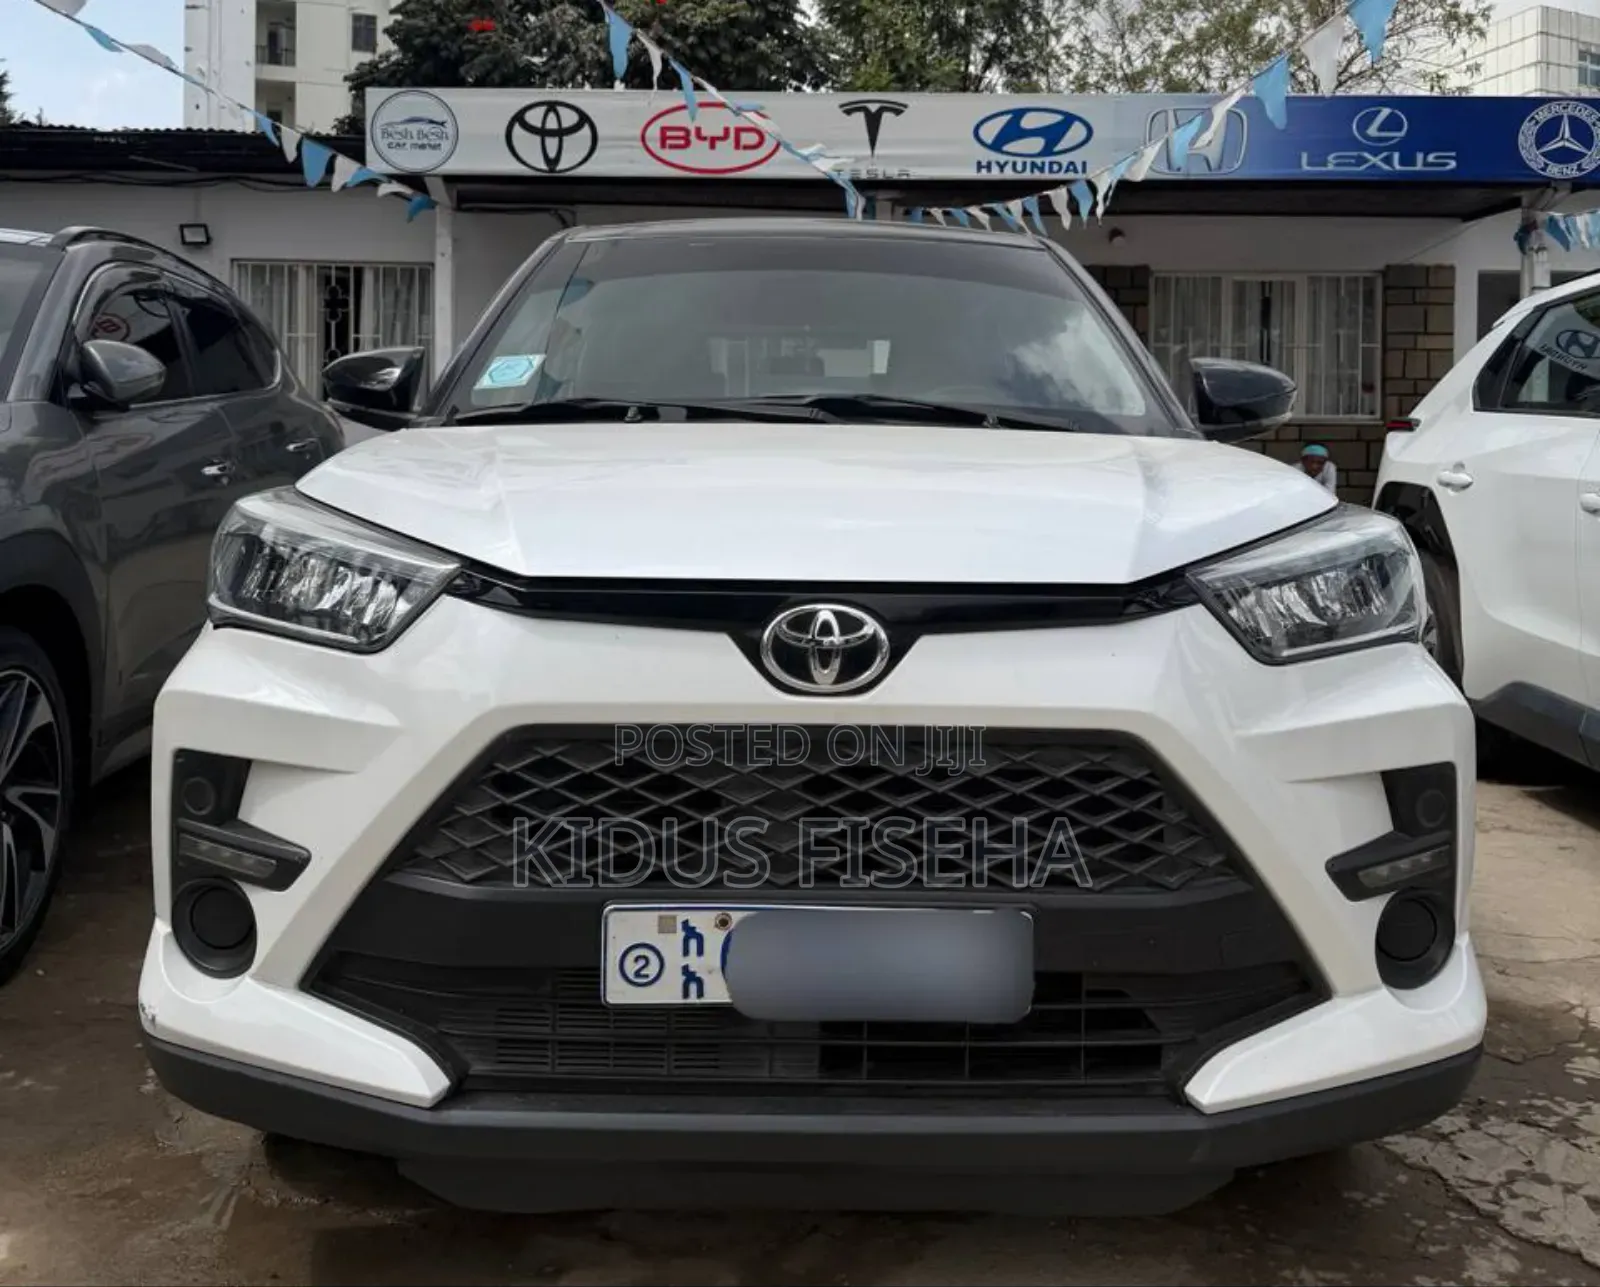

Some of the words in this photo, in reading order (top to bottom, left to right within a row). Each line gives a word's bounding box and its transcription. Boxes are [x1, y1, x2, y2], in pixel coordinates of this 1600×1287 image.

[660, 126, 765, 150] BYD
[976, 160, 1087, 174] HYUNDAI
[1301, 152, 1457, 171] LEXUS
[633, 955, 650, 979] 2
